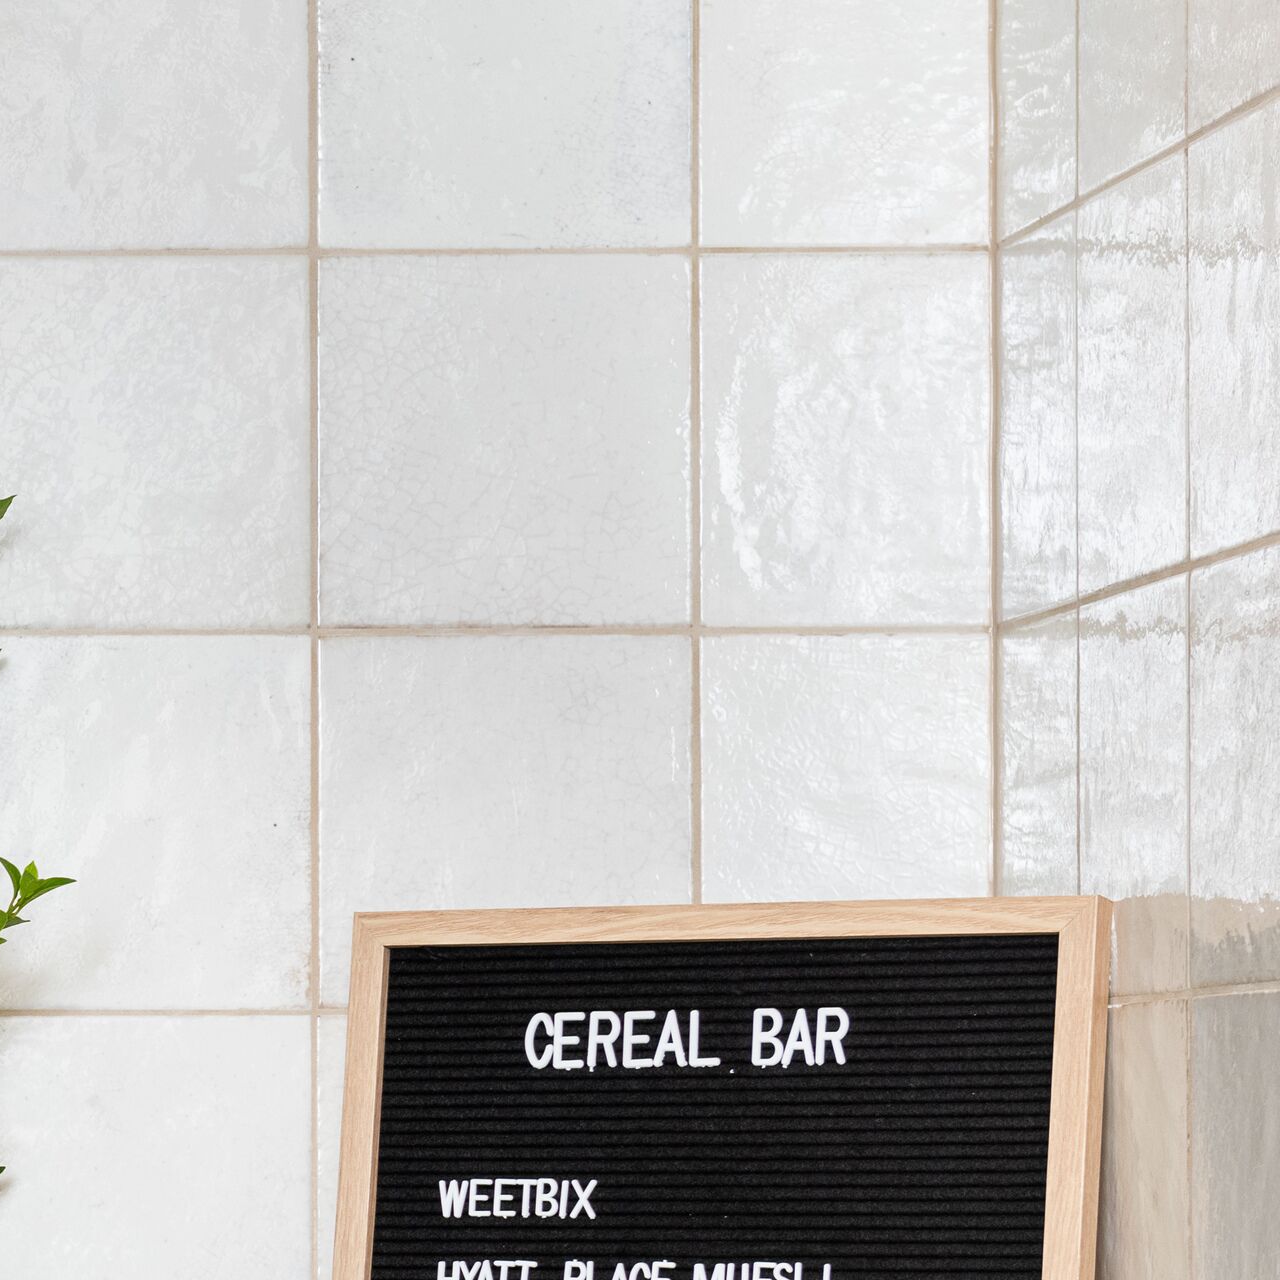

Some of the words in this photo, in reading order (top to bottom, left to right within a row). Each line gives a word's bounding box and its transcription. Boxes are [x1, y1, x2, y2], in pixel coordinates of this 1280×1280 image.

[525, 1010, 720, 1072] CEREAL
[752, 1007, 849, 1068] BAR
[439, 1178, 597, 1219] WEETBIX
